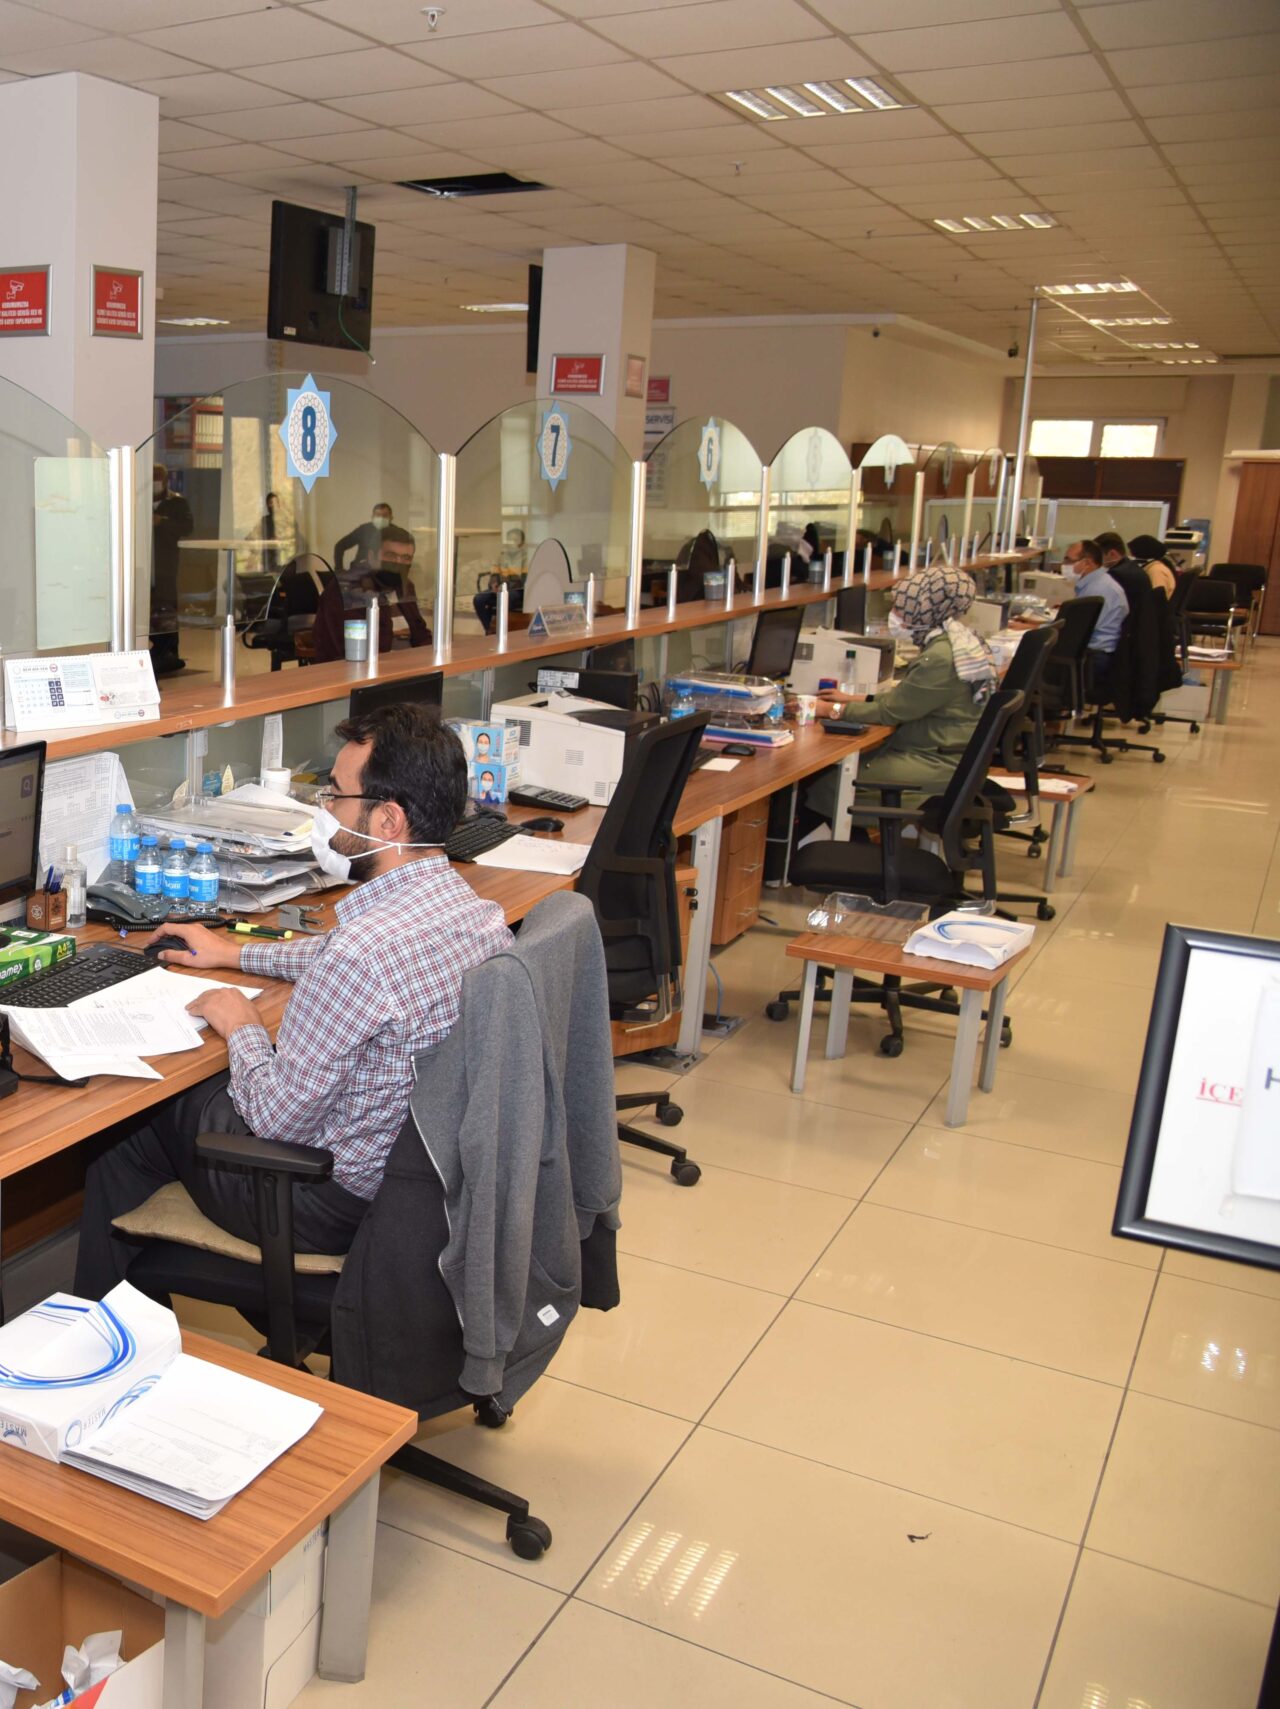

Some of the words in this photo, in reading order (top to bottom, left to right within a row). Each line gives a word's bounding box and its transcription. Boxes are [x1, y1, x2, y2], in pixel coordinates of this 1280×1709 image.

[302, 405, 316, 462] 8
[550, 424, 561, 468] 7
[706, 436, 714, 472] 6
[57, 942, 68, 957] A4
